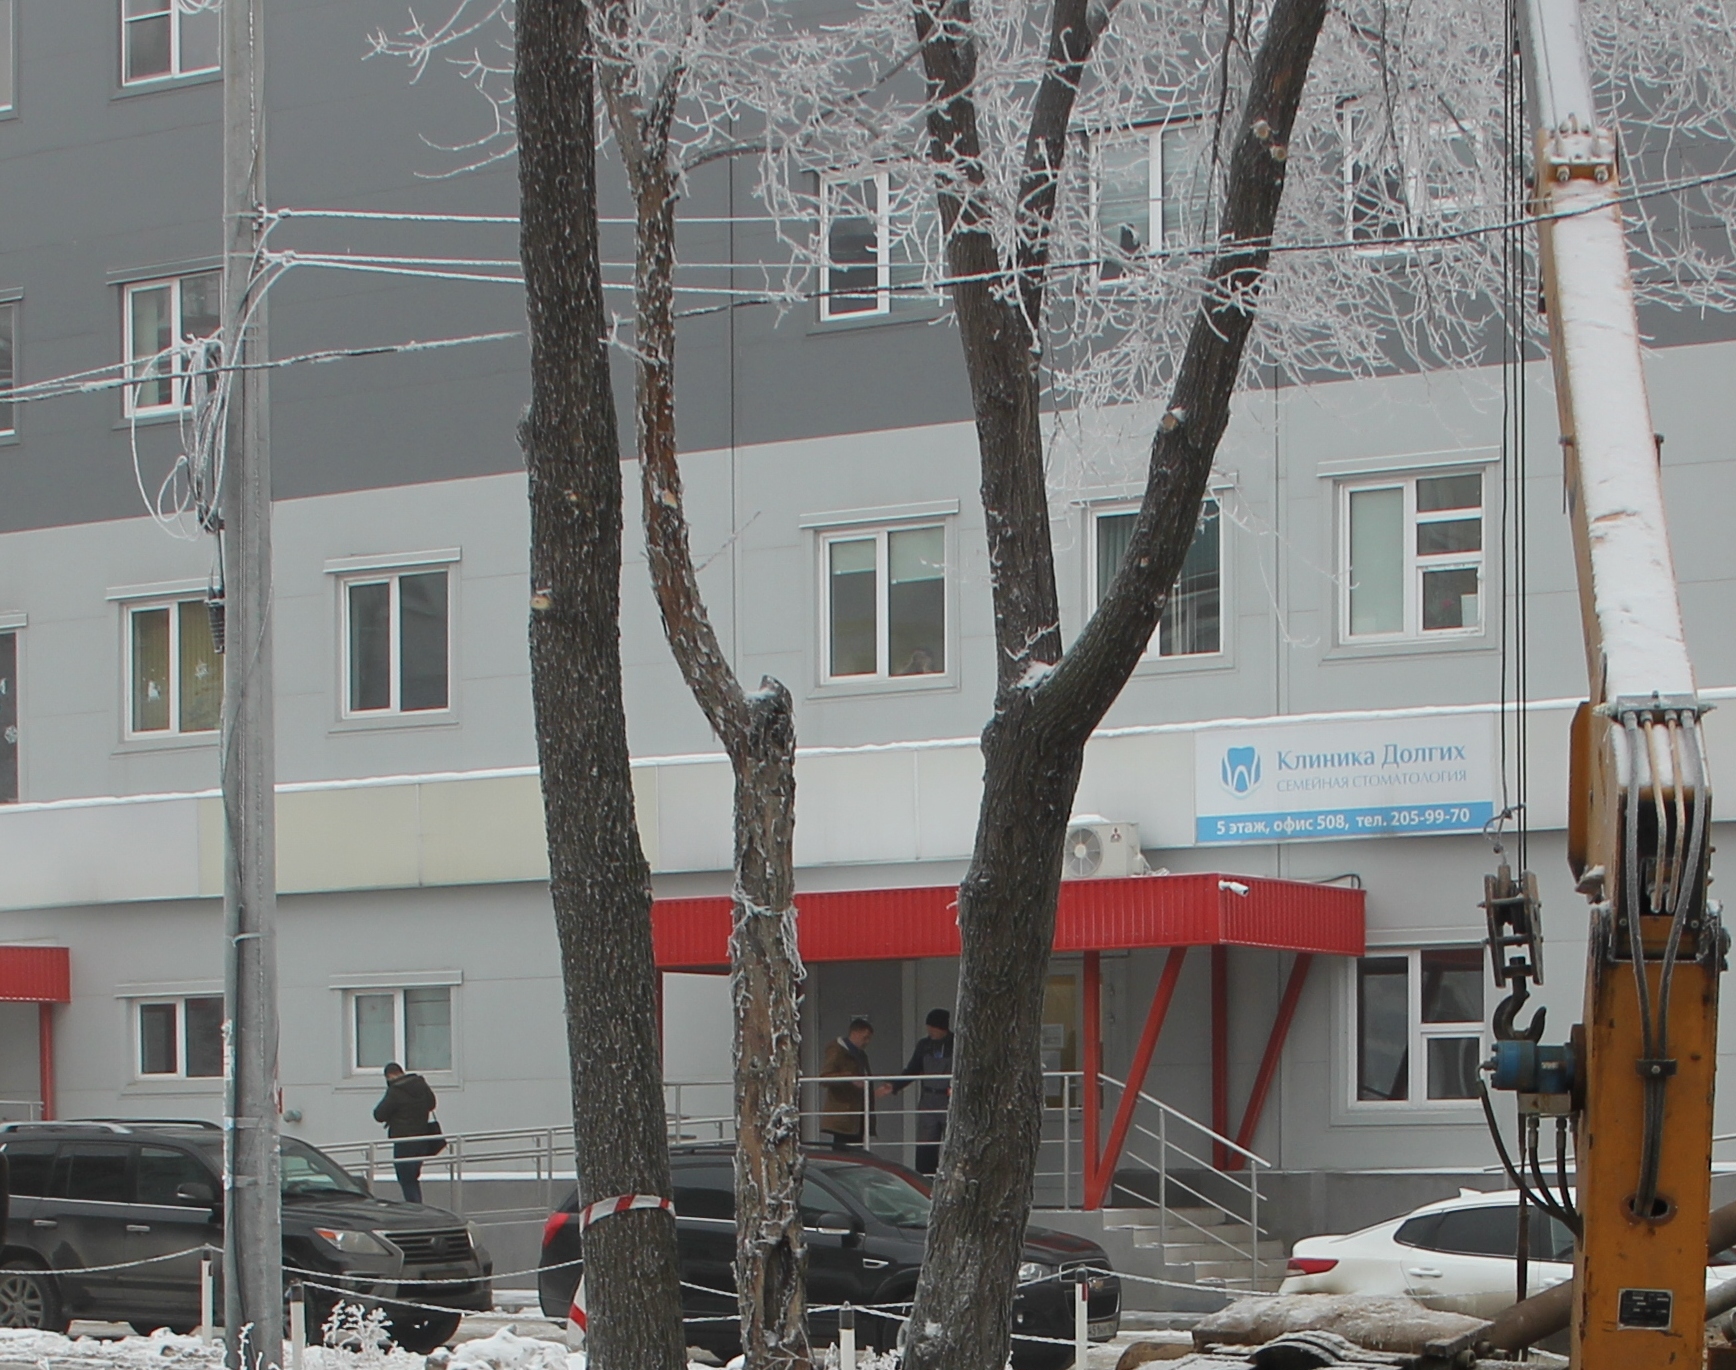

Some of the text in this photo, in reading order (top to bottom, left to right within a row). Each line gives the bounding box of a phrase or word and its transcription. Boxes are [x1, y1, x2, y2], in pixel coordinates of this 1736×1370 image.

[1276, 743, 1466, 771] Клиника Долгих
[1276, 770, 1467, 792] СЕМЕЙНАЯ СТОМАТОЛОГИЯ
[1216, 808, 1470, 835] 5 этаж, офис 508, тел. 205-99-70
